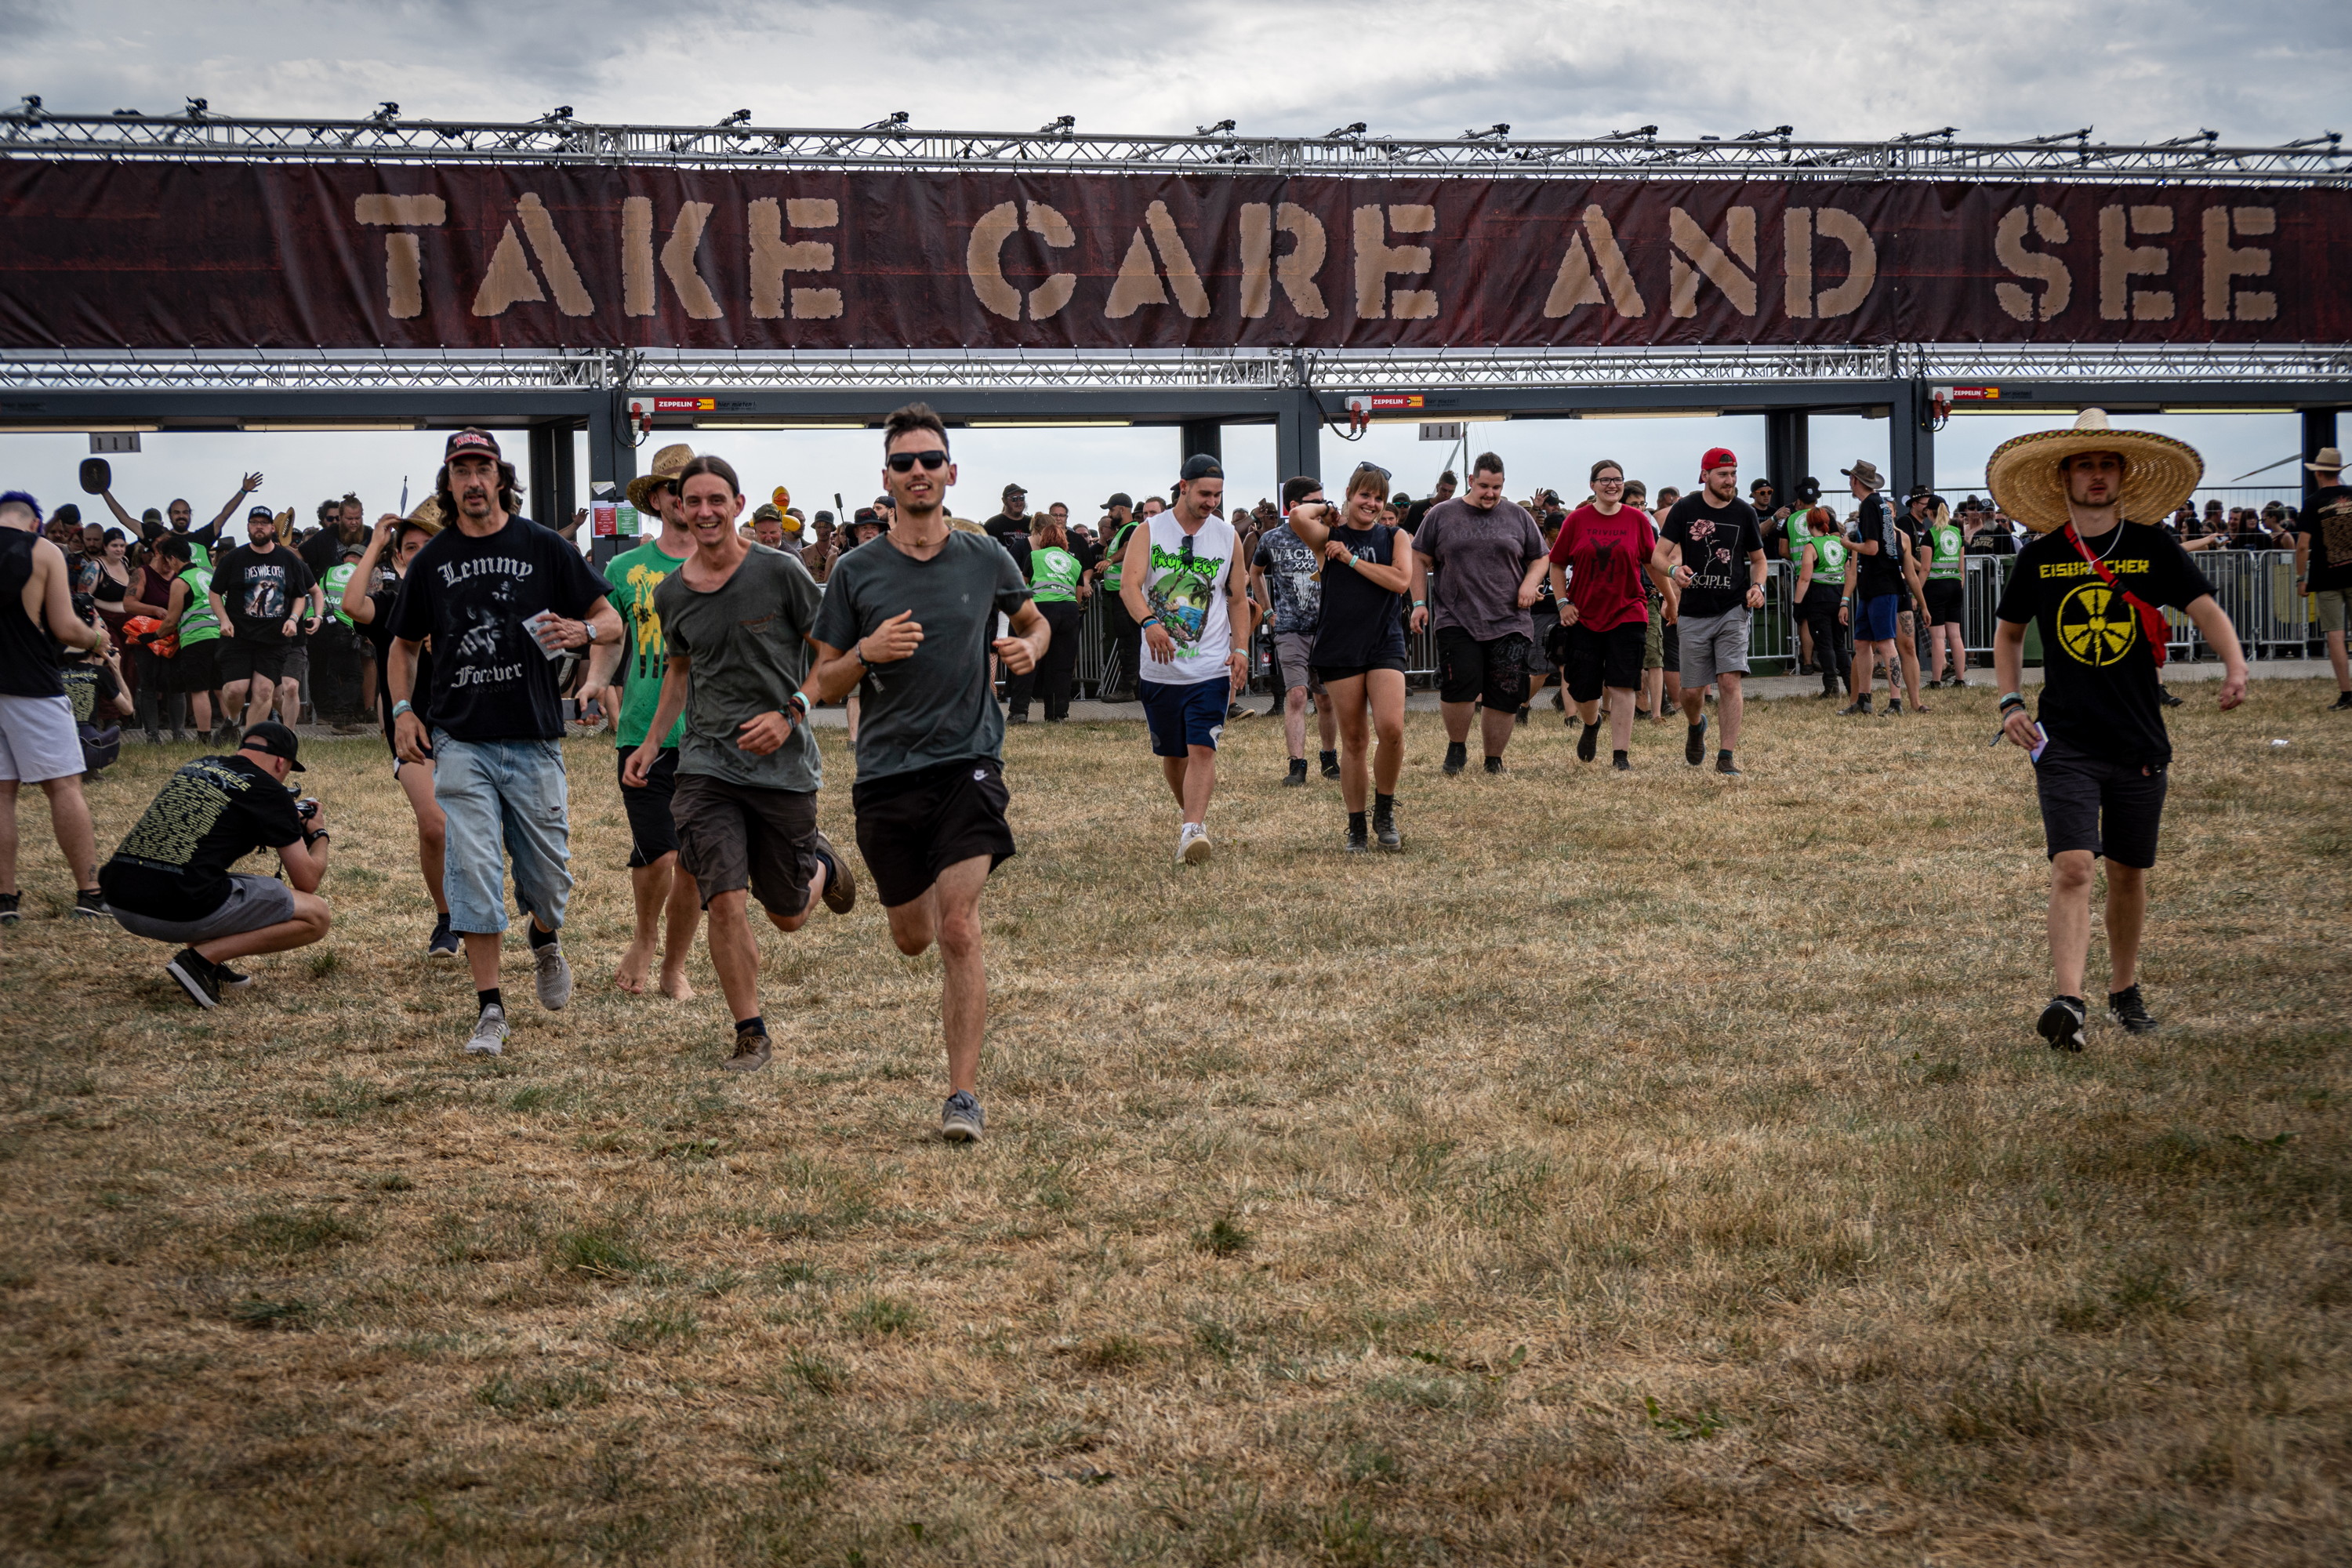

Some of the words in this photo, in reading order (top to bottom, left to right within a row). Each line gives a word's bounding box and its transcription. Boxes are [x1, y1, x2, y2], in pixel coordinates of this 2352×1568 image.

[355, 191, 843, 319] TAKE
[967, 199, 1439, 321] CARE
[1543, 203, 1879, 318] AND
[1995, 203, 2278, 321] SEE
[1270, 547, 1316, 562] WACK
[245, 565, 258, 580] EYES
[257, 564, 270, 578] WIDE
[271, 565, 285, 580] OPEN
[437, 556, 533, 588] Lemmy
[2038, 559, 2150, 579] EISBRCHER
[451, 662, 523, 688] Forever
